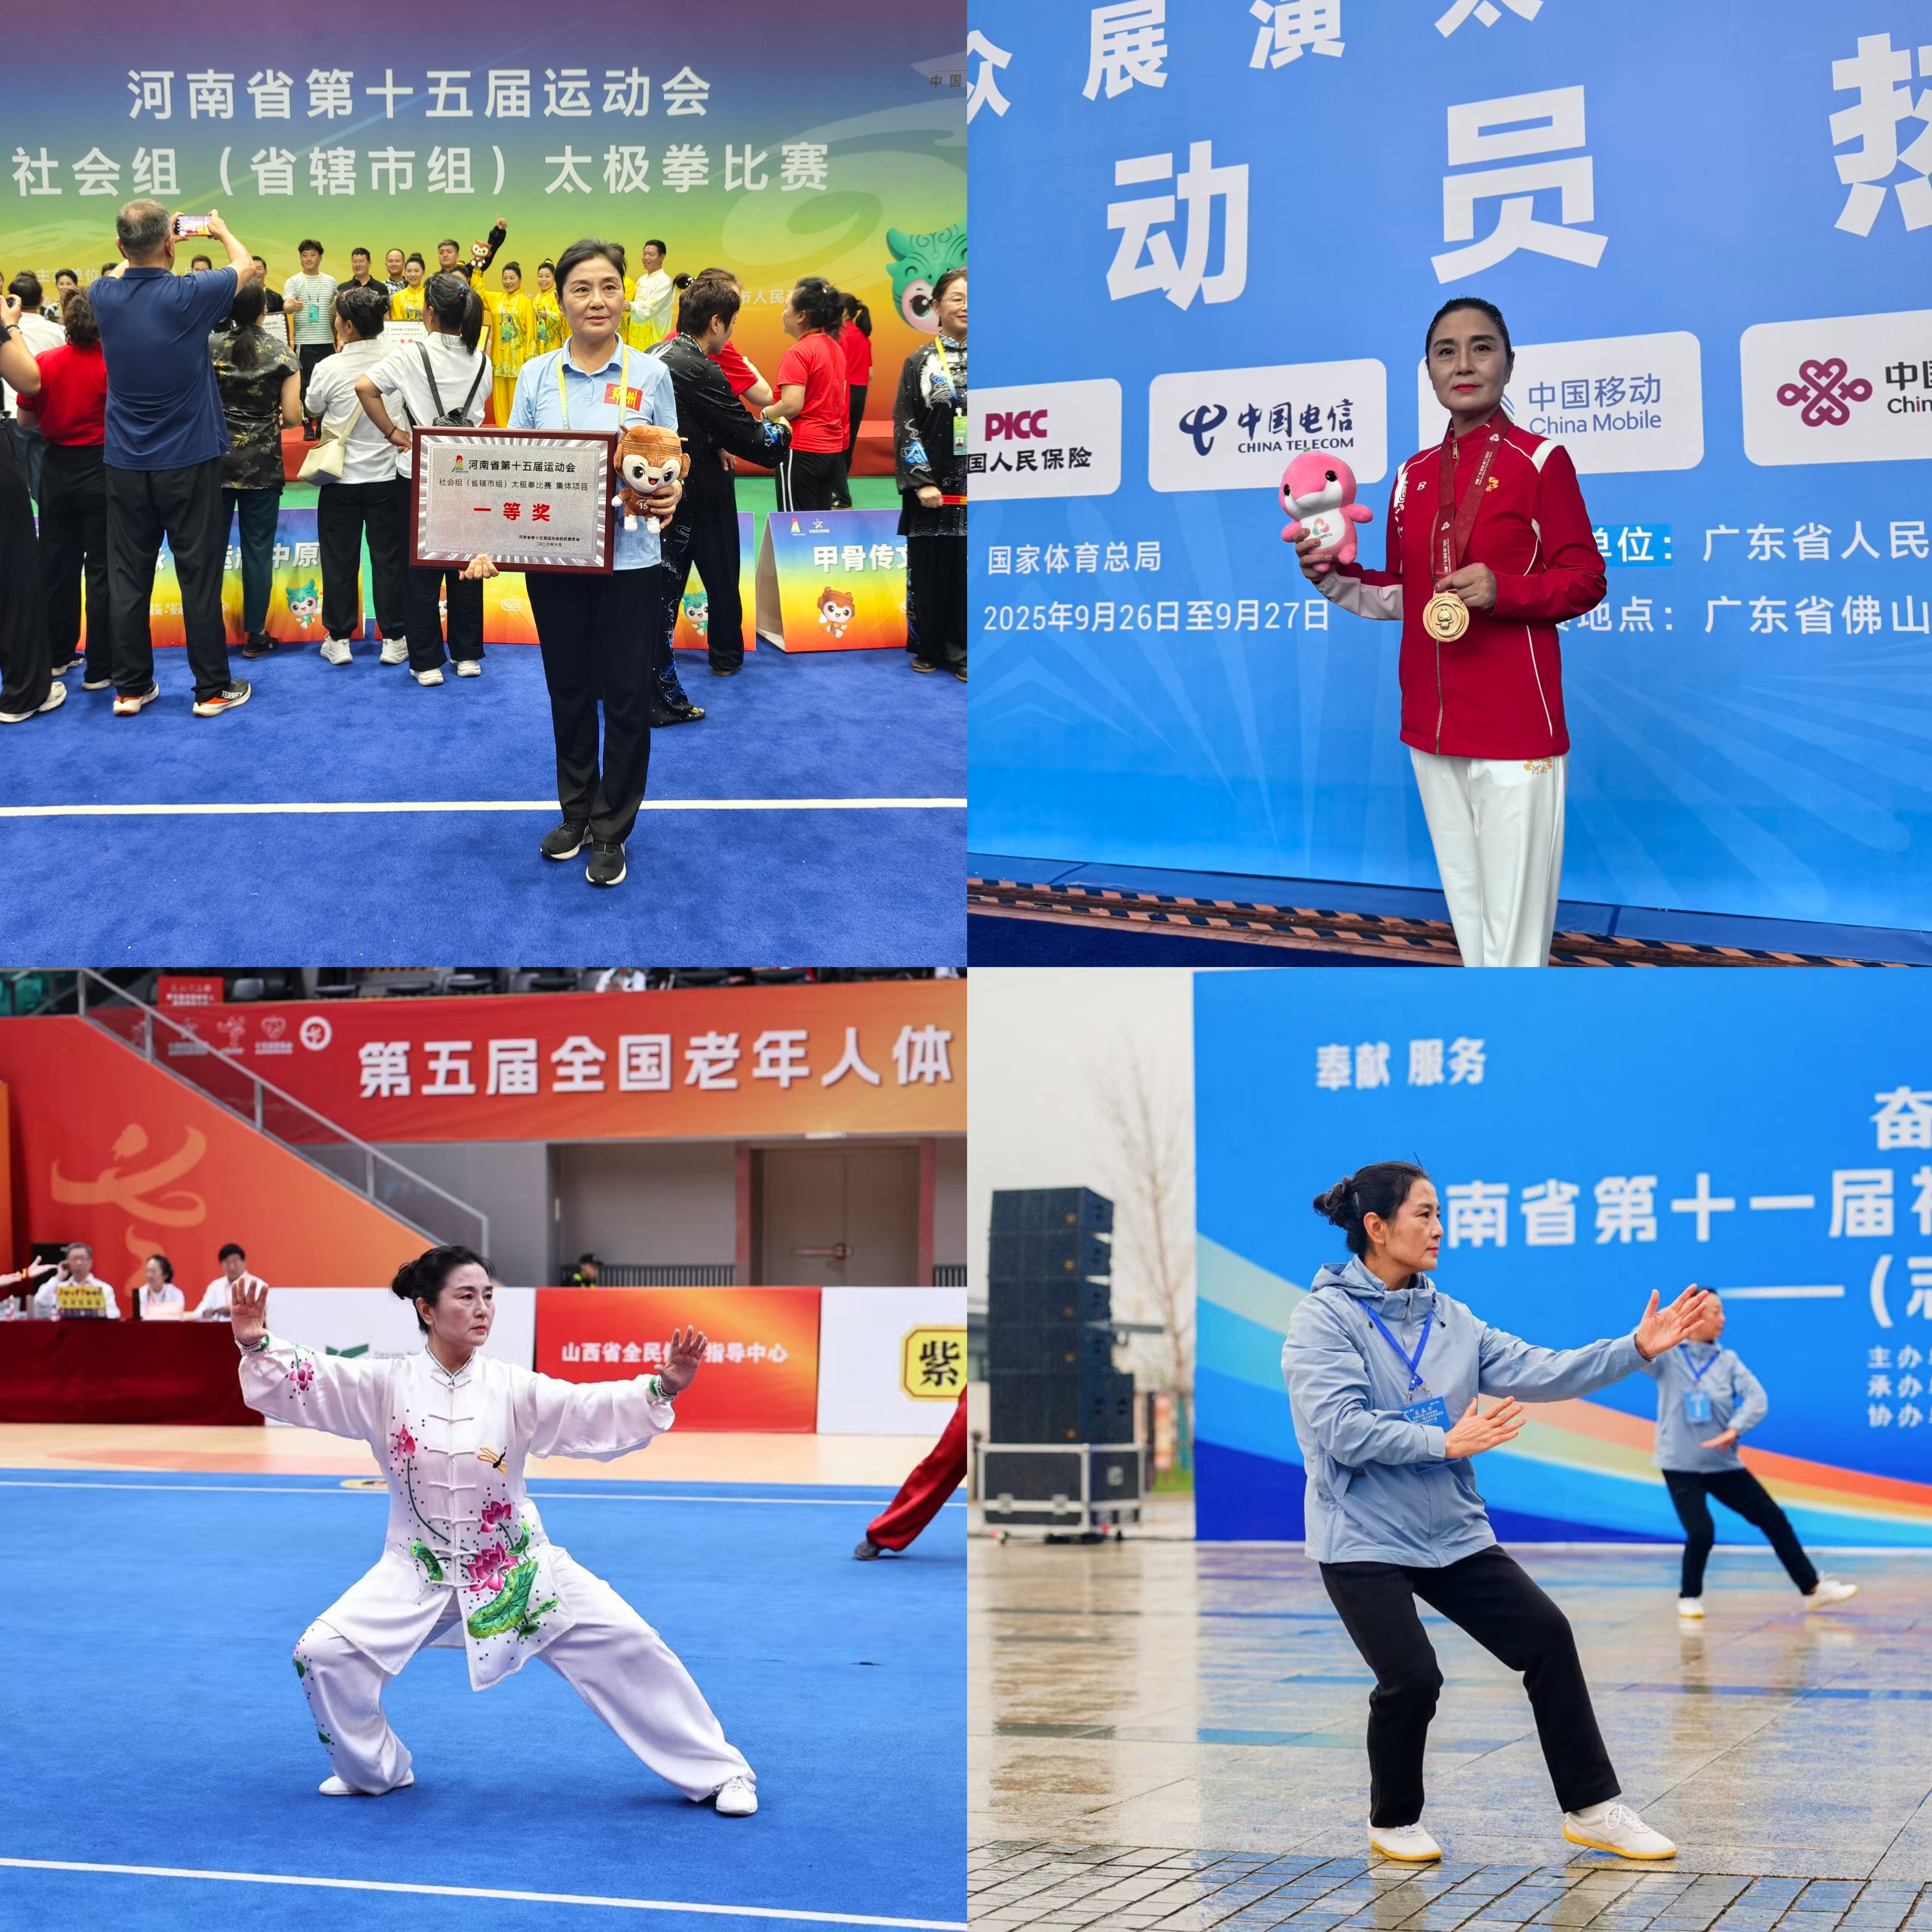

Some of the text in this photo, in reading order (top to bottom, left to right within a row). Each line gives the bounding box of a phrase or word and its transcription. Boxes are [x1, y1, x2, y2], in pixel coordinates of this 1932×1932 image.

[128, 66, 711, 119] 河南省第十五届运动会
[12, 142, 829, 196] 社会组（省辖市组）太极拳比赛
[1529, 373, 1660, 412] 中国移动
[985, 409, 1048, 441] PICC
[1238, 398, 1353, 441] 中国电信
[1529, 410, 1662, 434] China Mobile
[967, 446, 1092, 474] 国人民保险
[1238, 437, 1353, 453] CHINA TELECOM
[468, 459, 576, 473] 河南省第十五届运动会
[556, 482, 588, 490] 集体项目
[473, 502, 550, 522] 一等奖
[1703, 520, 1929, 562] 广东省人民
[988, 541, 1161, 575] 国家体育总局
[984, 599, 1329, 632] 2025年9月26日至9月27日
[1555, 595, 1930, 634] 地点： 广东省佛山
[359, 1024, 952, 1098] 第五届全国老年人体
[1315, 1037, 1487, 1090] 奉献 服务
[561, 1341, 789, 1364] 山西省全民指导中心
[919, 1340, 960, 1386] 紫
[1867, 1344, 1932, 1369] 主办
[1867, 1373, 1932, 1399] 承办
[1867, 1403, 1932, 1428] 协办
